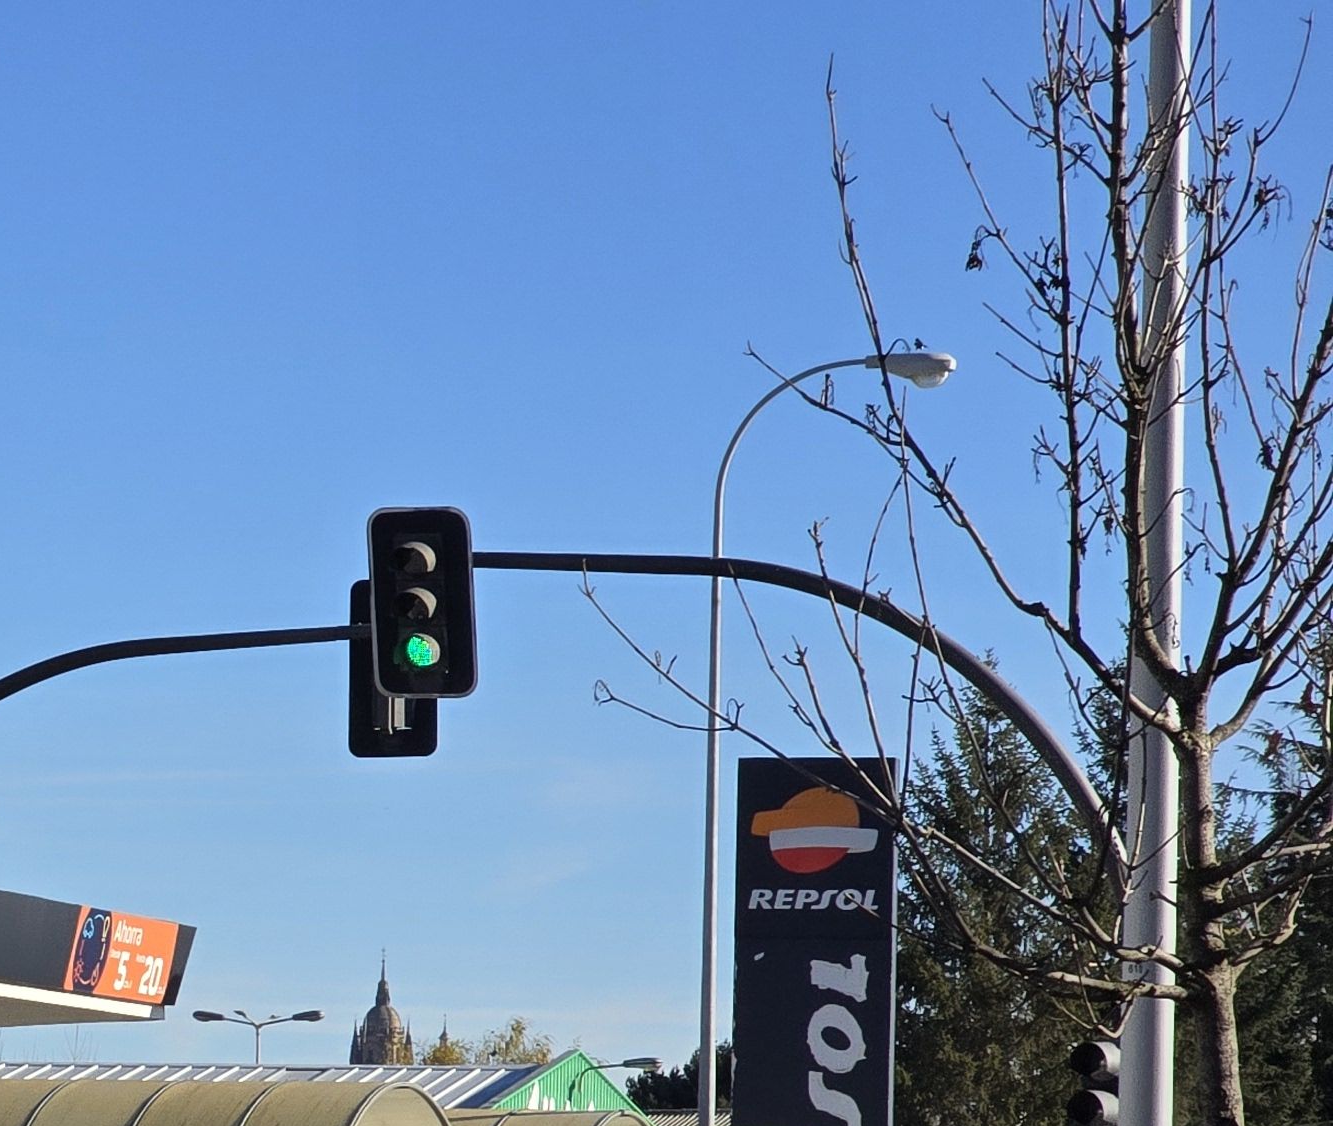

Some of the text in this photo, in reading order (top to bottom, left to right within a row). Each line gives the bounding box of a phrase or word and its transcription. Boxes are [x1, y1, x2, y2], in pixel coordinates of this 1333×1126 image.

[748, 888, 880, 910] REPSOL
[114, 920, 143, 946] Ahorra
[138, 955, 164, 996] 20
